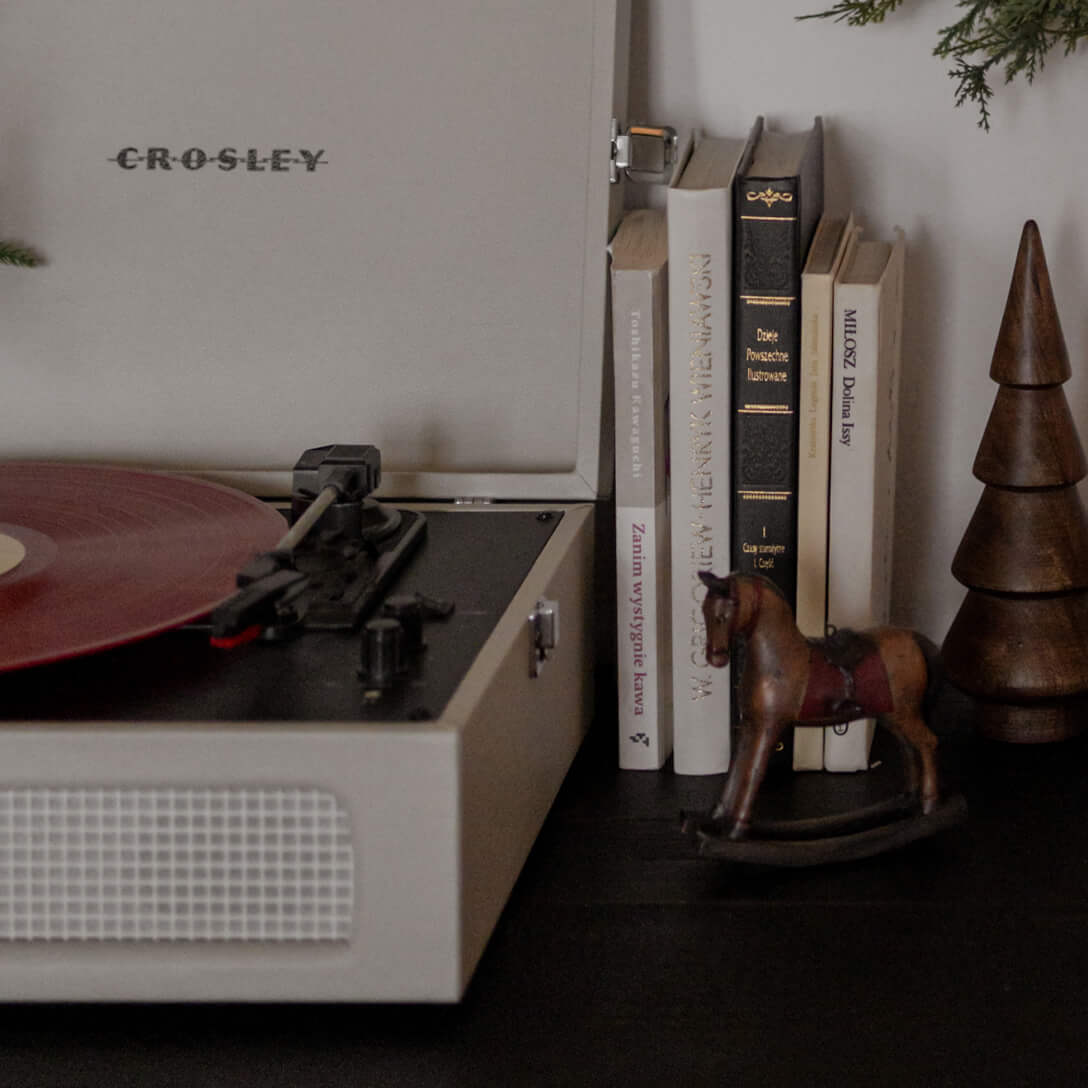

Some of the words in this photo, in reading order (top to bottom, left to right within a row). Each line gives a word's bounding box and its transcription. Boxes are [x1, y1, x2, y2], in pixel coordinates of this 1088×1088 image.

[112, 146, 326, 172] CROSLEY
[756, 327, 780, 344] Dzieje
[746, 347, 790, 363] Powszechne
[747, 367, 788, 383] Ilustrowane
[841, 377, 856, 419] Dolina
[839, 419, 855, 446] Issy
[632, 523, 646, 578] Zanim
[629, 581, 647, 669] wystygnie
[633, 673, 648, 716] kawa
